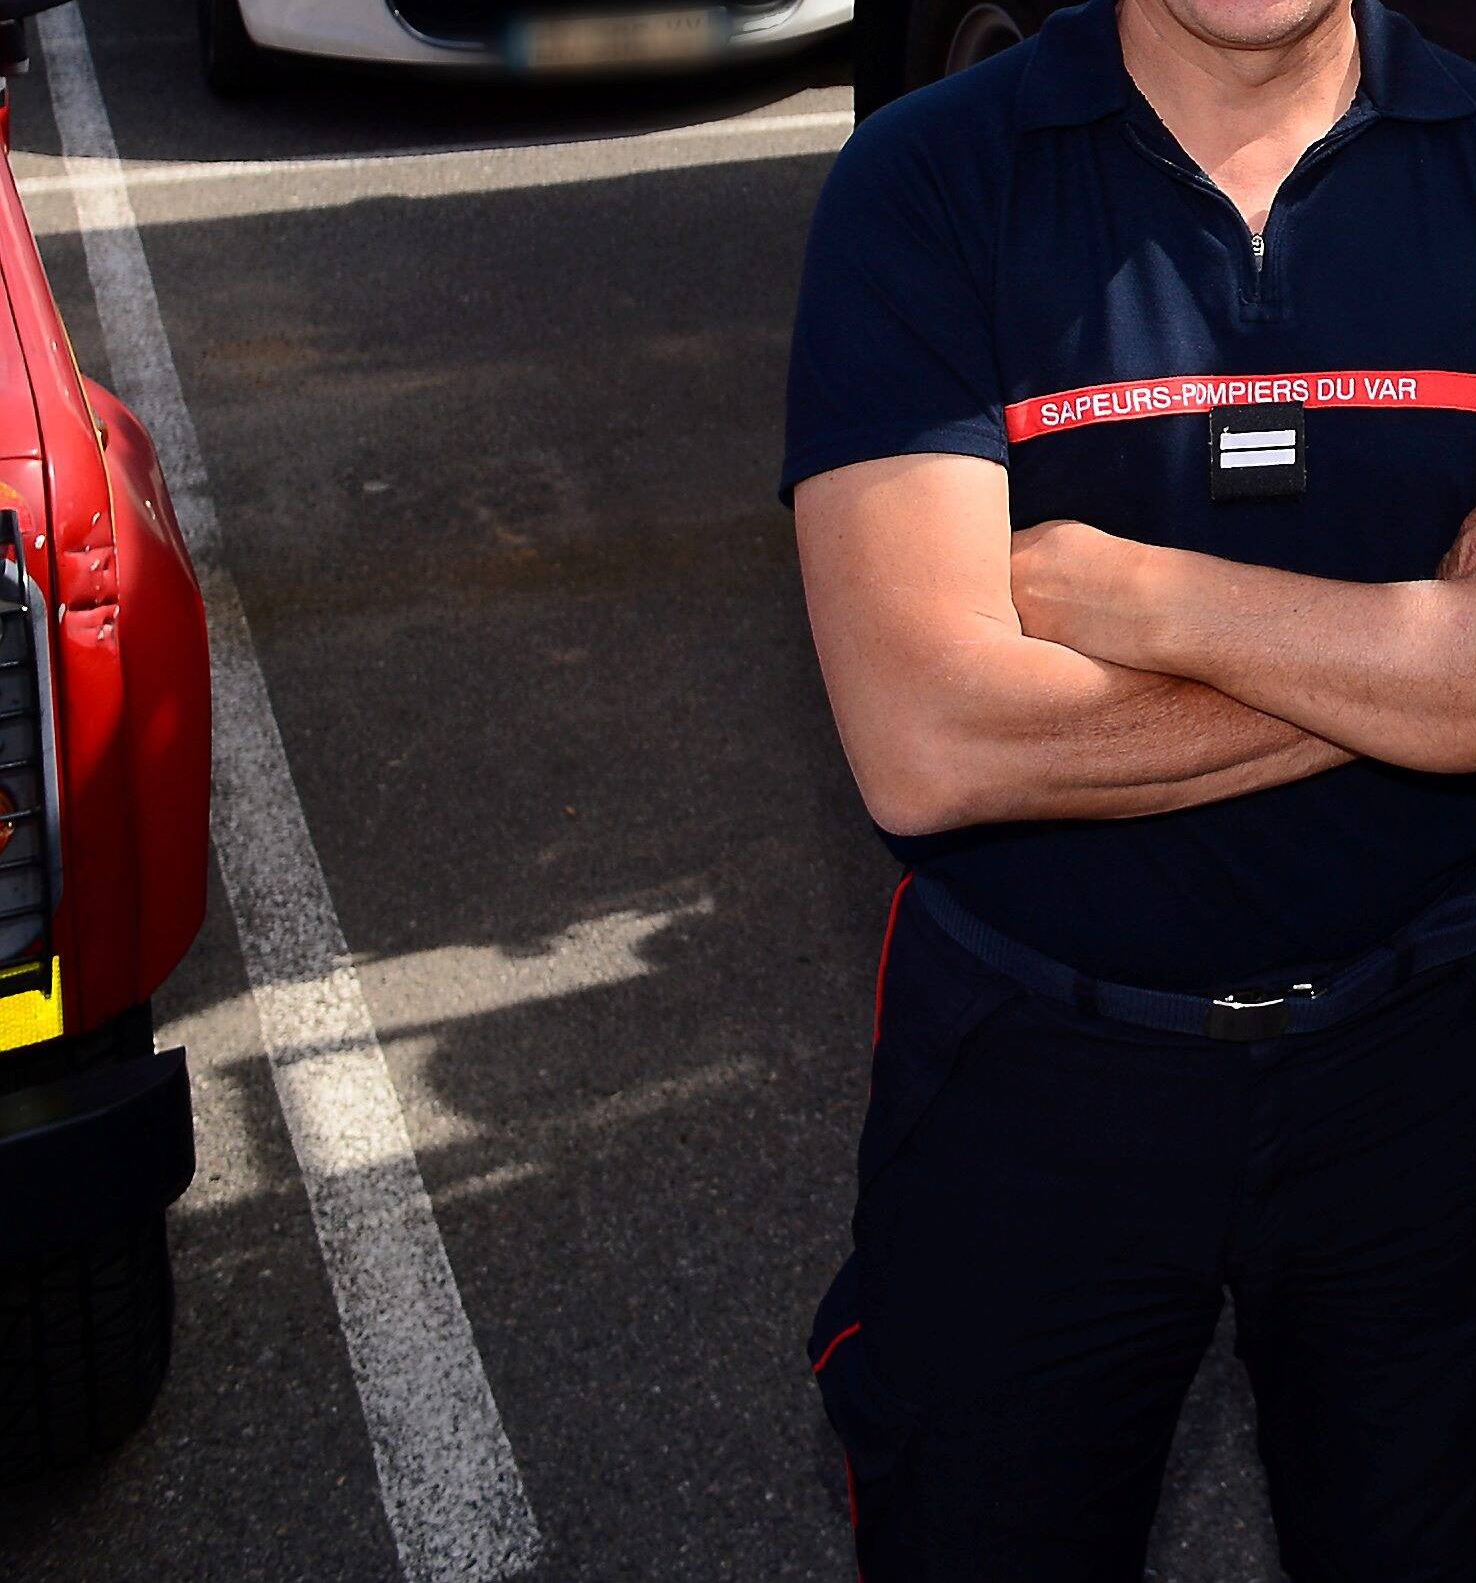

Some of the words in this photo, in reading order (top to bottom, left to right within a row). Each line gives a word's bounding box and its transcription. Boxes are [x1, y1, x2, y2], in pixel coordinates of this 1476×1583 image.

[1040, 378, 1310, 427] SAPEURS-POMPIERS
[1316, 378, 1356, 402] DU
[1366, 378, 1417, 401] VAR
